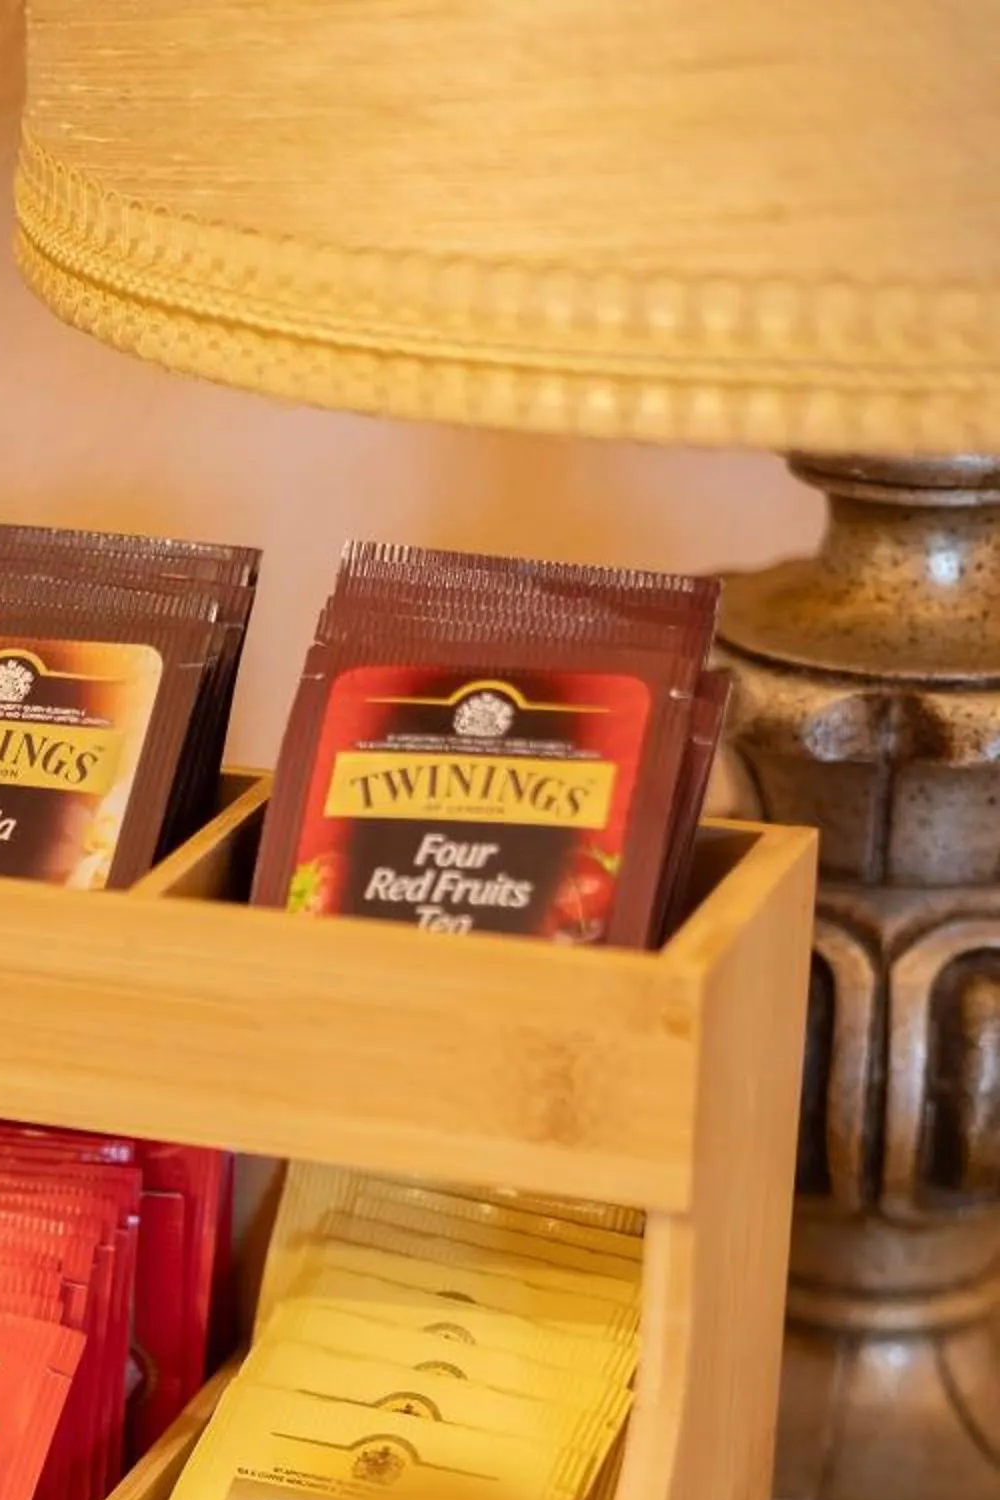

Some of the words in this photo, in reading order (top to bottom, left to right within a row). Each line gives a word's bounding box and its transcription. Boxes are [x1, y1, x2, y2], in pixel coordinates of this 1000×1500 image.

[351, 763, 591, 818] TWININGS
[413, 832, 499, 868] Four
[364, 866, 437, 902] Red
[430, 869, 534, 908] Fruits
